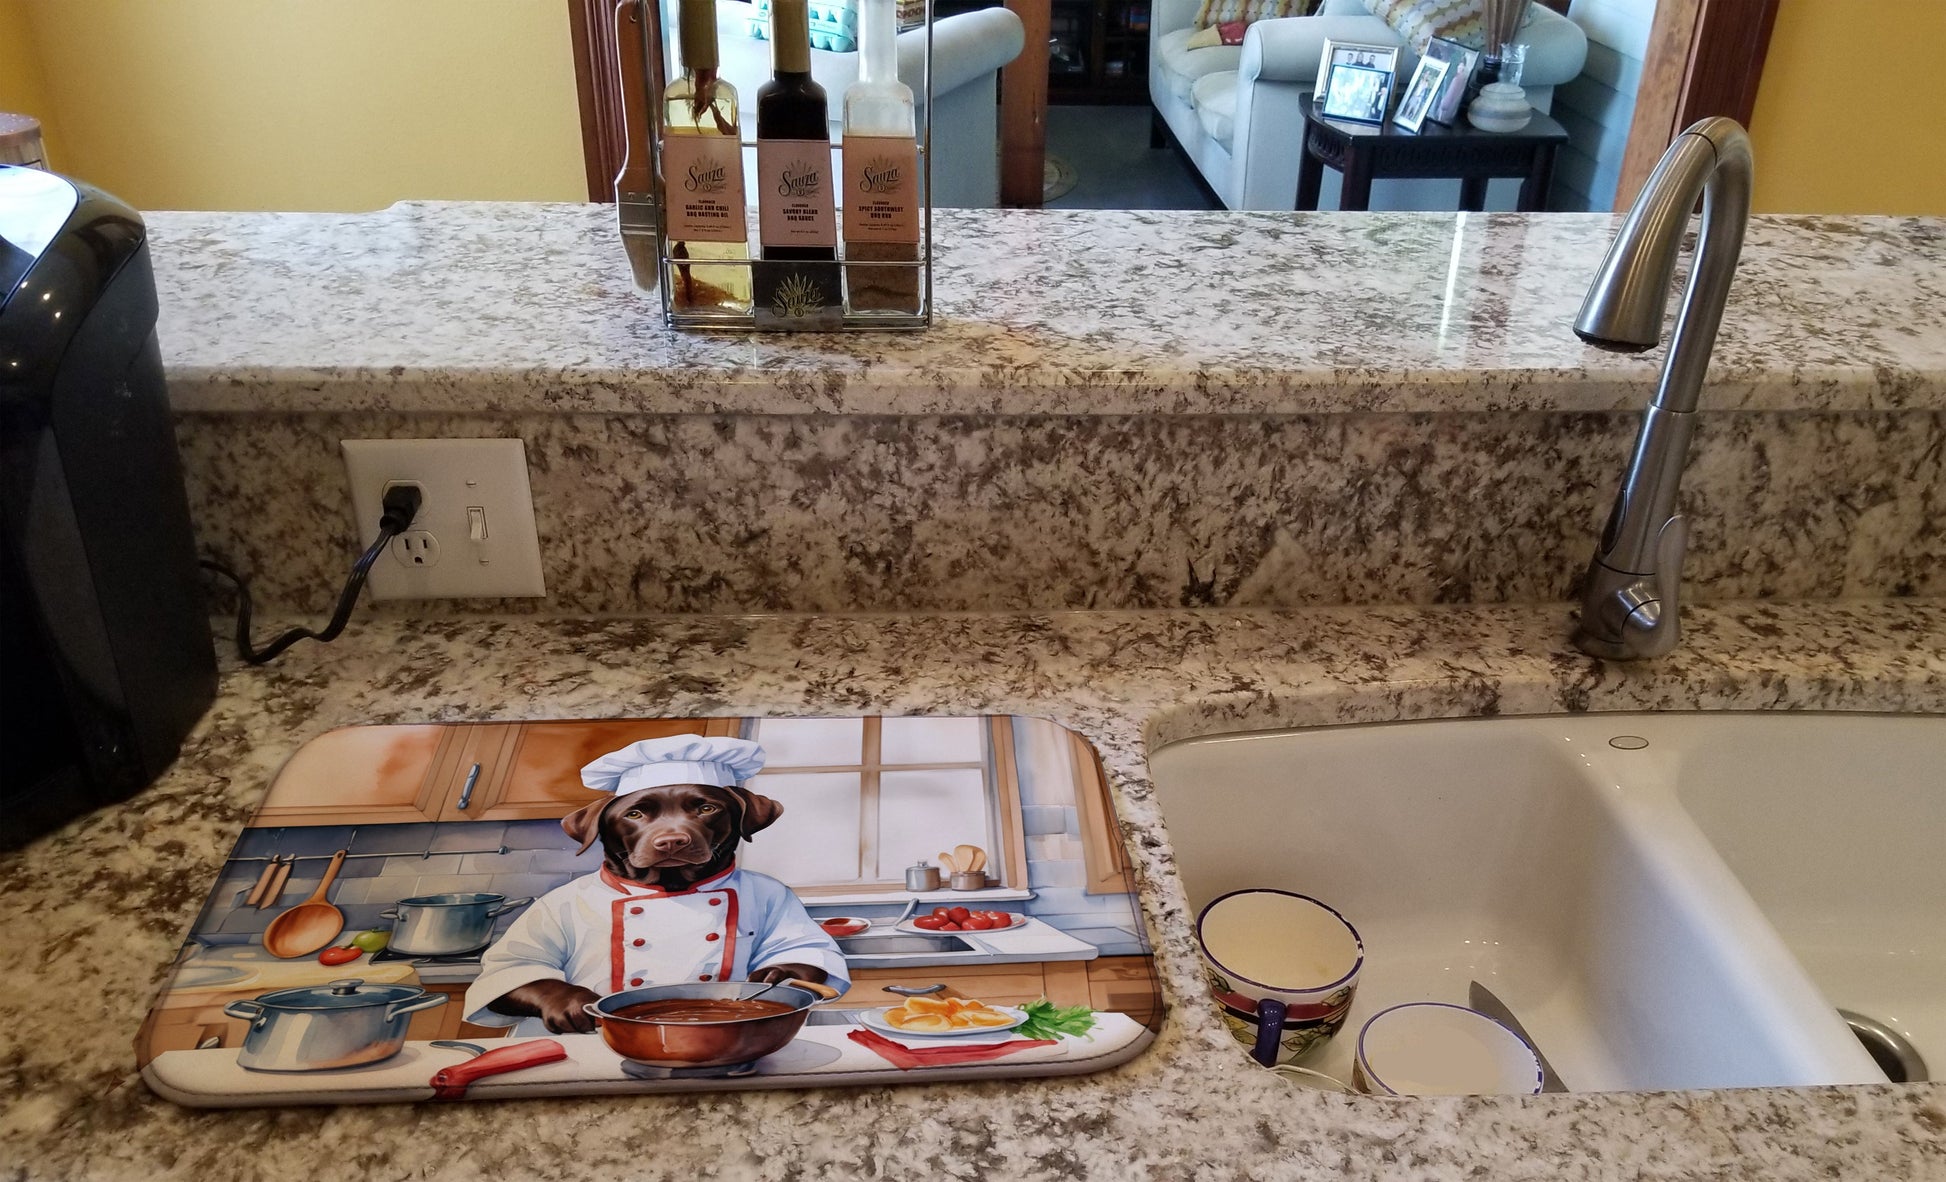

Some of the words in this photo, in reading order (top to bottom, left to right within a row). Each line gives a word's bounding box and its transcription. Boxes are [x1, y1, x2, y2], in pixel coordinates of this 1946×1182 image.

[685, 165, 726, 192] Sauza
[778, 170, 818, 197] Sauza
[860, 167, 900, 193] Sauza
[771, 288, 824, 318] Sauza
